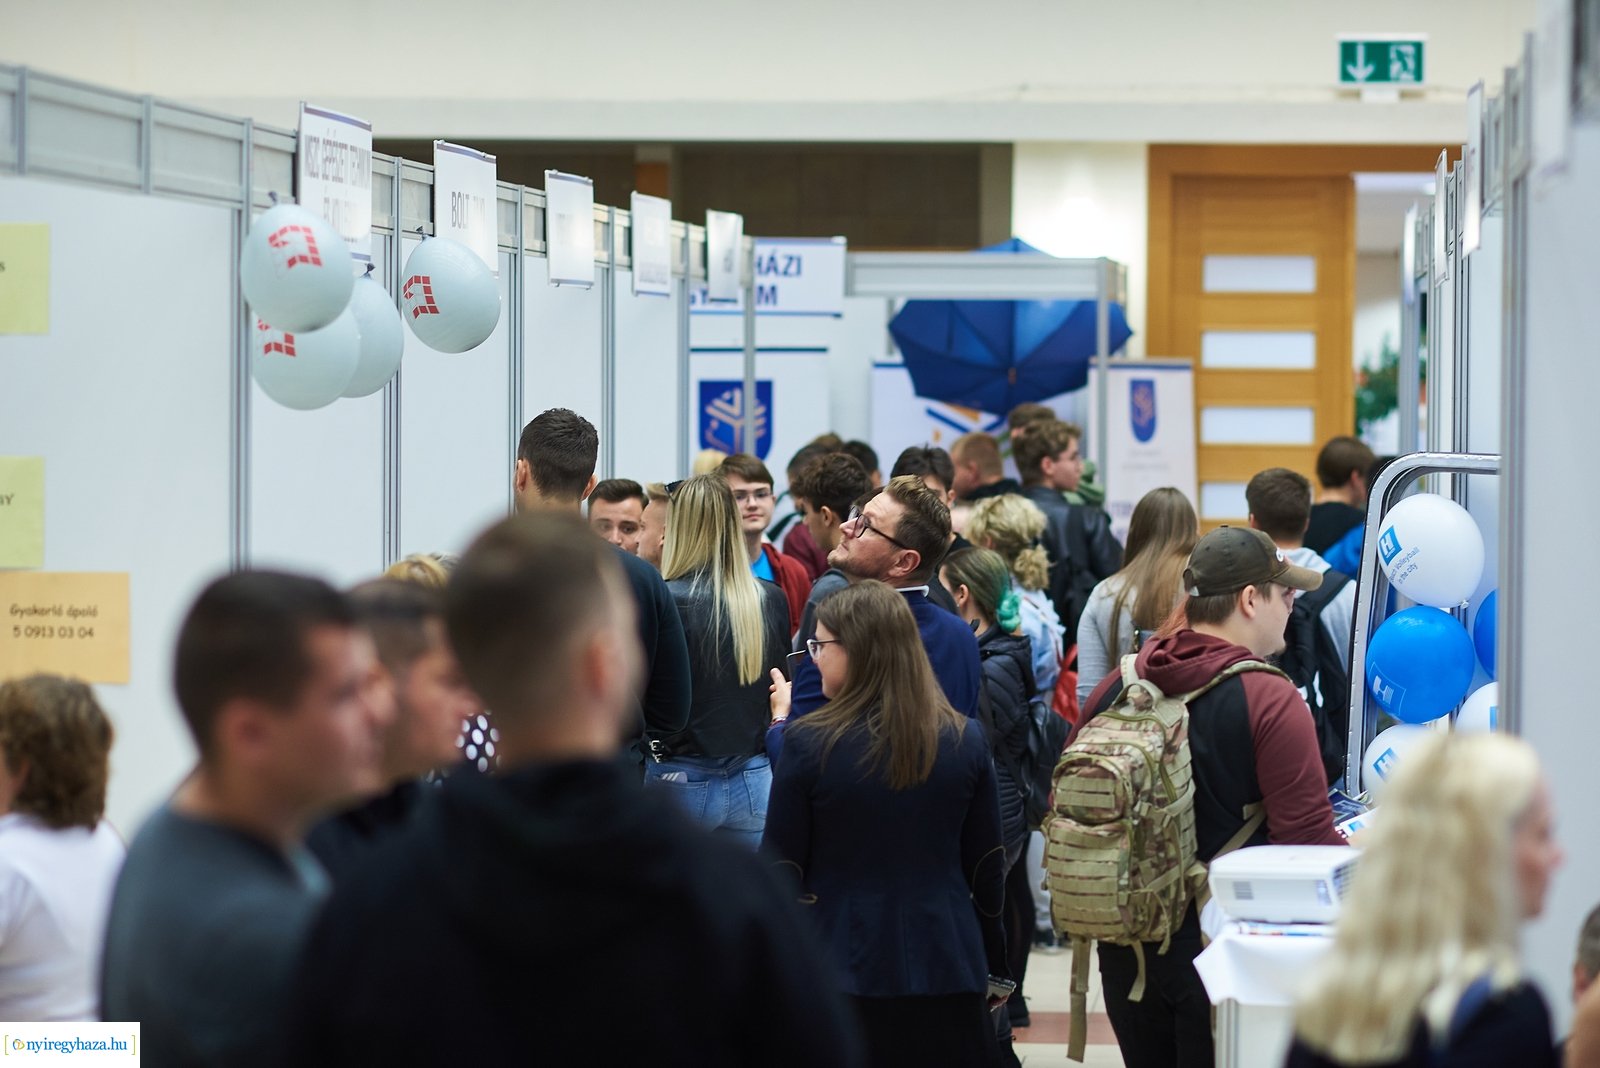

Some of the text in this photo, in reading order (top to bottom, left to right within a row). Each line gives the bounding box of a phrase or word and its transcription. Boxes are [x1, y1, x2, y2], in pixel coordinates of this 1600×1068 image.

[1406, 562, 1418, 573] city
[13, 625, 95, 638] 5 0913 03 04
